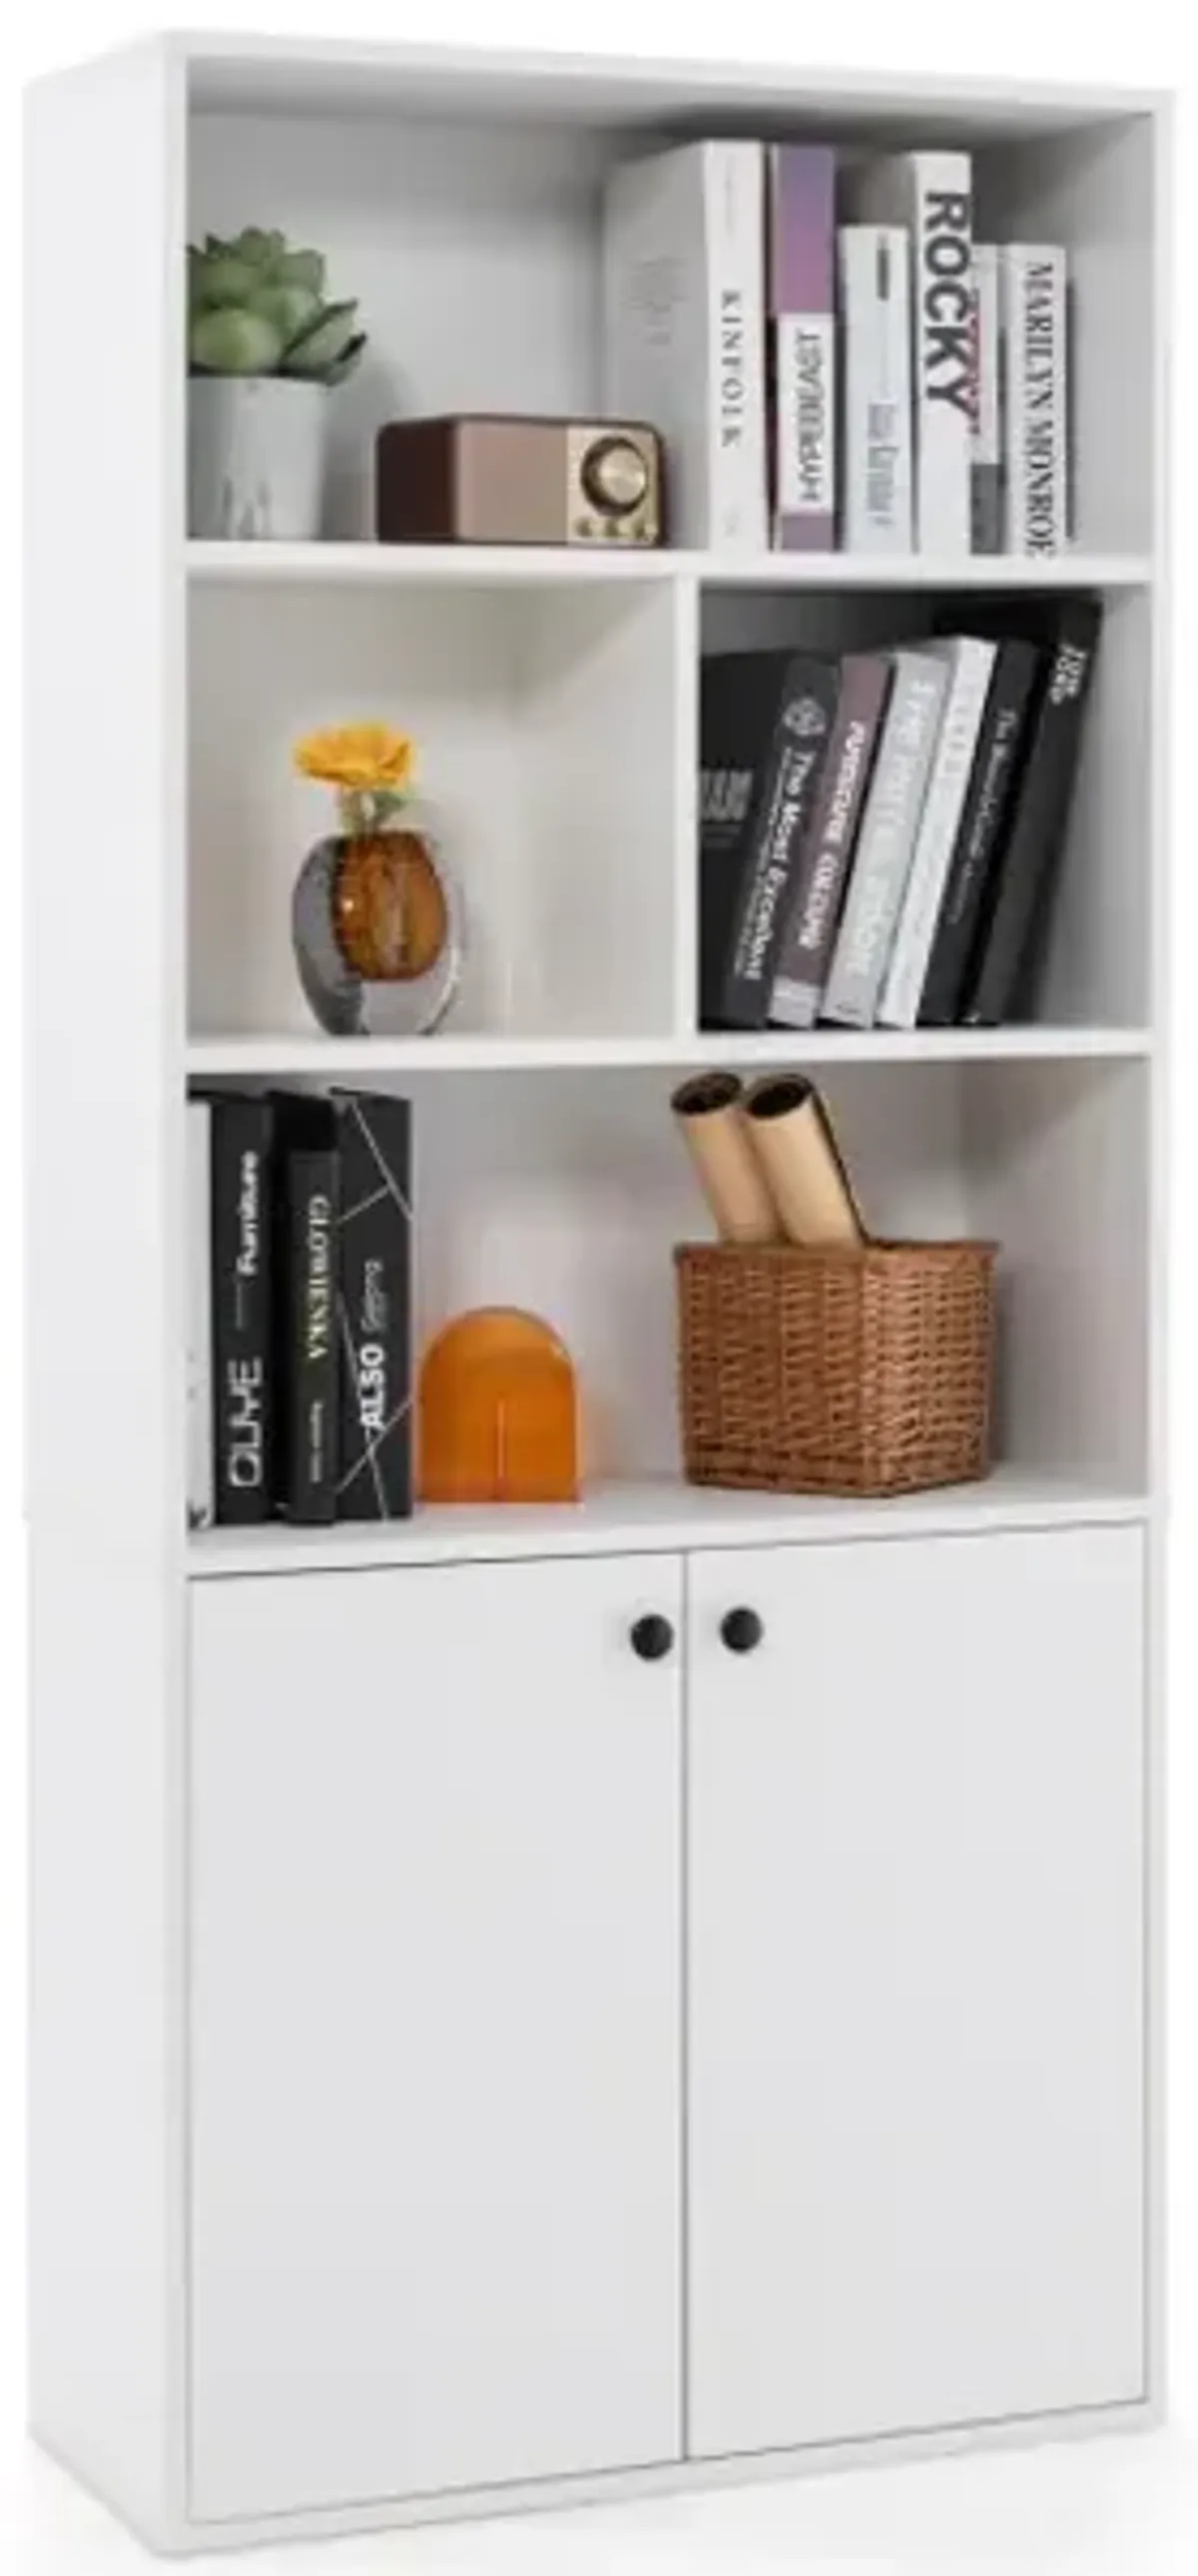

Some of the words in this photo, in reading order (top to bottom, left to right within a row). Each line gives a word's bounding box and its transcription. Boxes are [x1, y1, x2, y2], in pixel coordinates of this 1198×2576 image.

[721, 289, 745, 448] KINFOLK
[924, 192, 978, 419] ROCKY
[1023, 261, 1054, 408] MARILYN
[359, 1343, 387, 1431] ALSO
